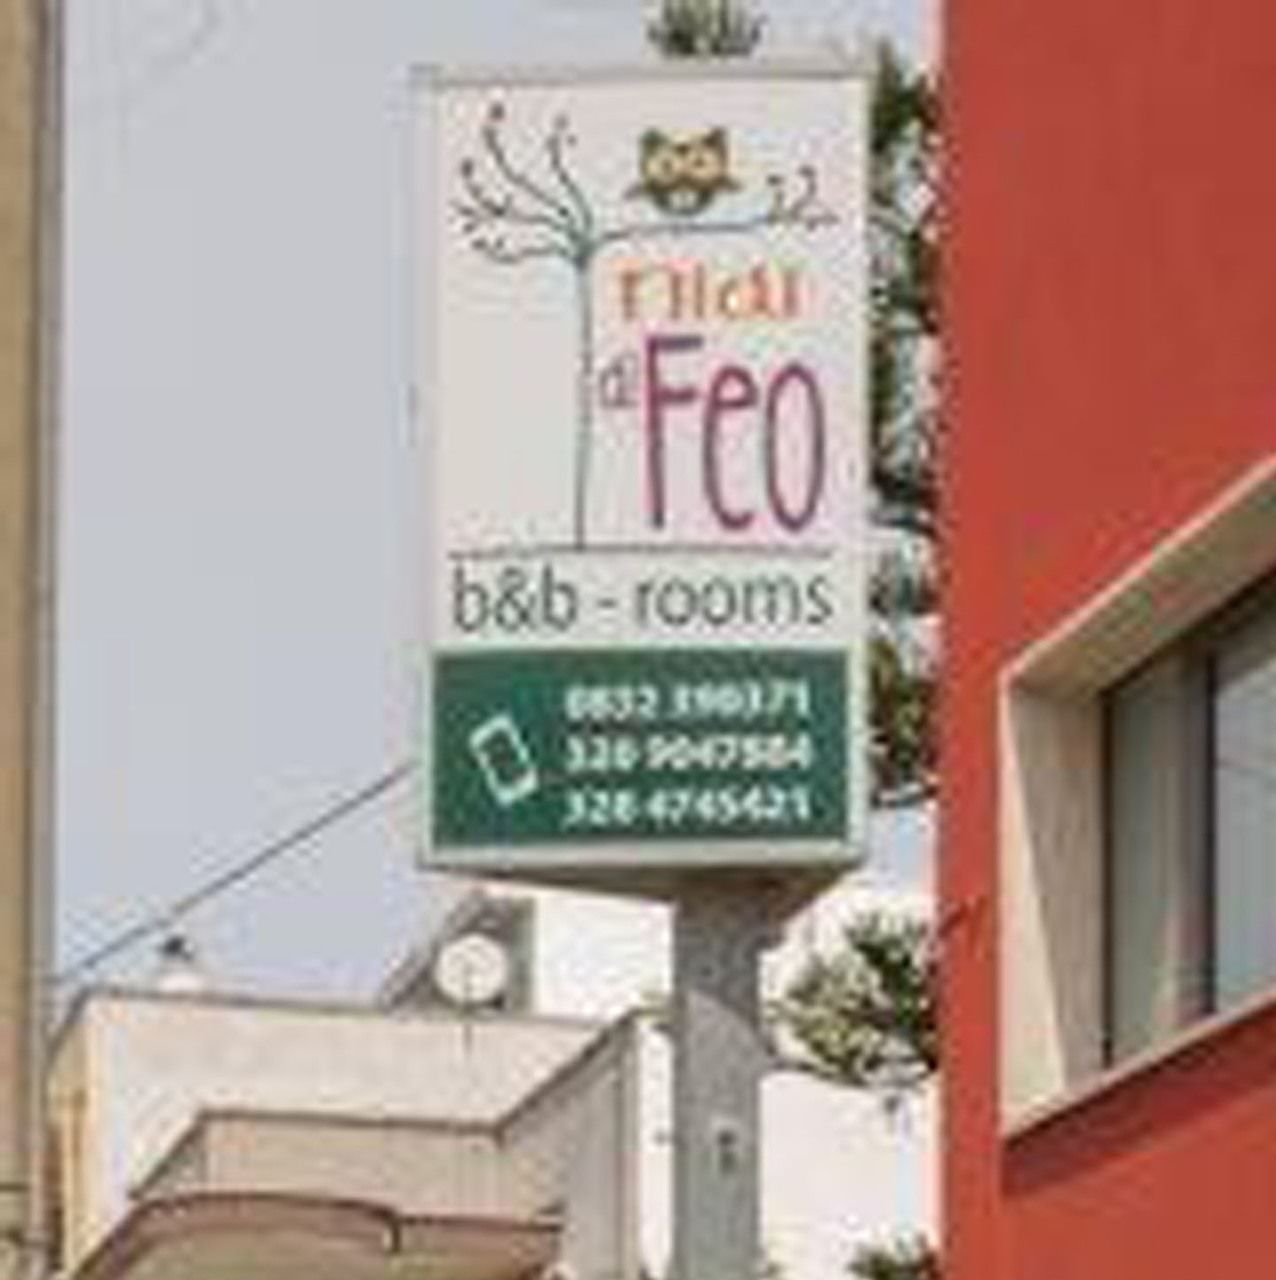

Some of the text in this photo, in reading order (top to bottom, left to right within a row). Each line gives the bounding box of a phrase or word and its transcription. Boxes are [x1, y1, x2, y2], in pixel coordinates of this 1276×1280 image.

[646, 334, 825, 531] Feo
[453, 562, 578, 633] b&b
[635, 572, 833, 627] rooms
